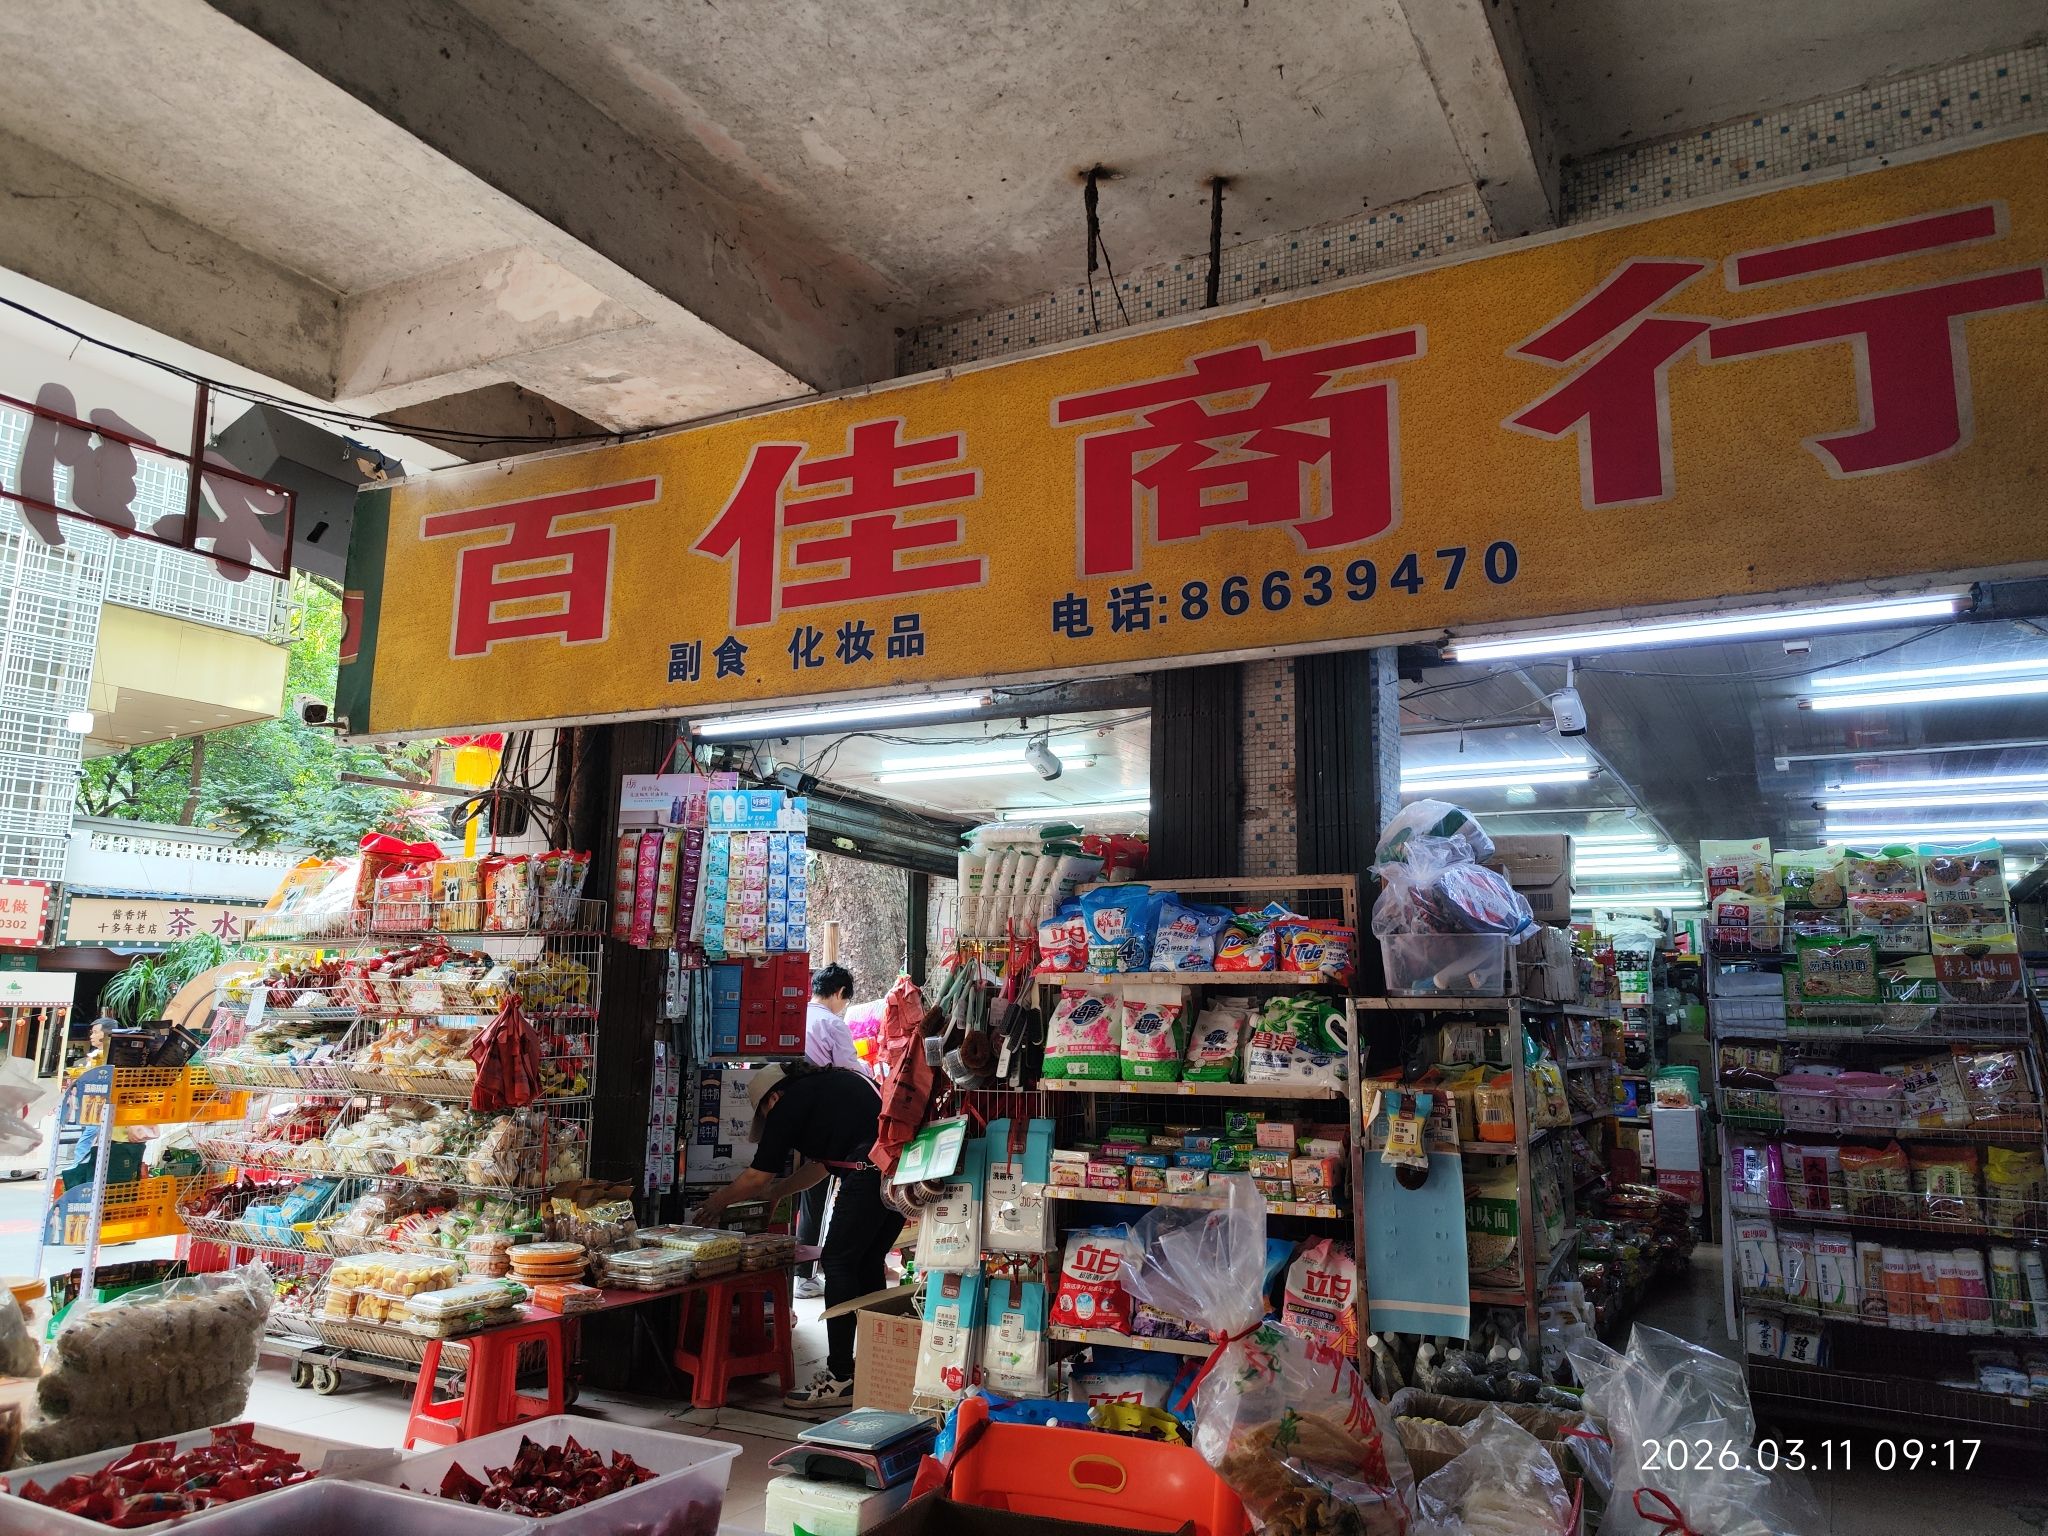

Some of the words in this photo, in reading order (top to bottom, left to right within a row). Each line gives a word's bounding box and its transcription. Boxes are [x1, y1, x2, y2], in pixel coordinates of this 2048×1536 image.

[422, 204, 2046, 658] 百佳商行
[667, 635, 749, 683] 副食
[787, 613, 927, 670] 化妆品
[112, 908, 148, 921] 酱香饼
[166, 907, 242, 938] 茶水
[97, 922, 158, 935] 十多年老店
[1050, 925, 1086, 945] 立白
[1116, 937, 1137, 961] 4
[1295, 943, 1325, 960] Tide
[1943, 960, 2013, 977] 荞麦风味面
[1068, 1004, 1107, 1023] 超能
[1134, 1017, 1165, 1031] 超能
[1251, 1032, 1298, 1054] 碧浪
[992, 1171, 1014, 1181] 洗碗布
[1011, 1183, 1016, 1192] 3
[961, 1203, 968, 1213] 3
[1019, 1195, 1043, 1209] 加大
[1070, 1244, 1121, 1274] 立白
[1302, 1269, 1352, 1302] 立白
[948, 1335, 954, 1344] 3
